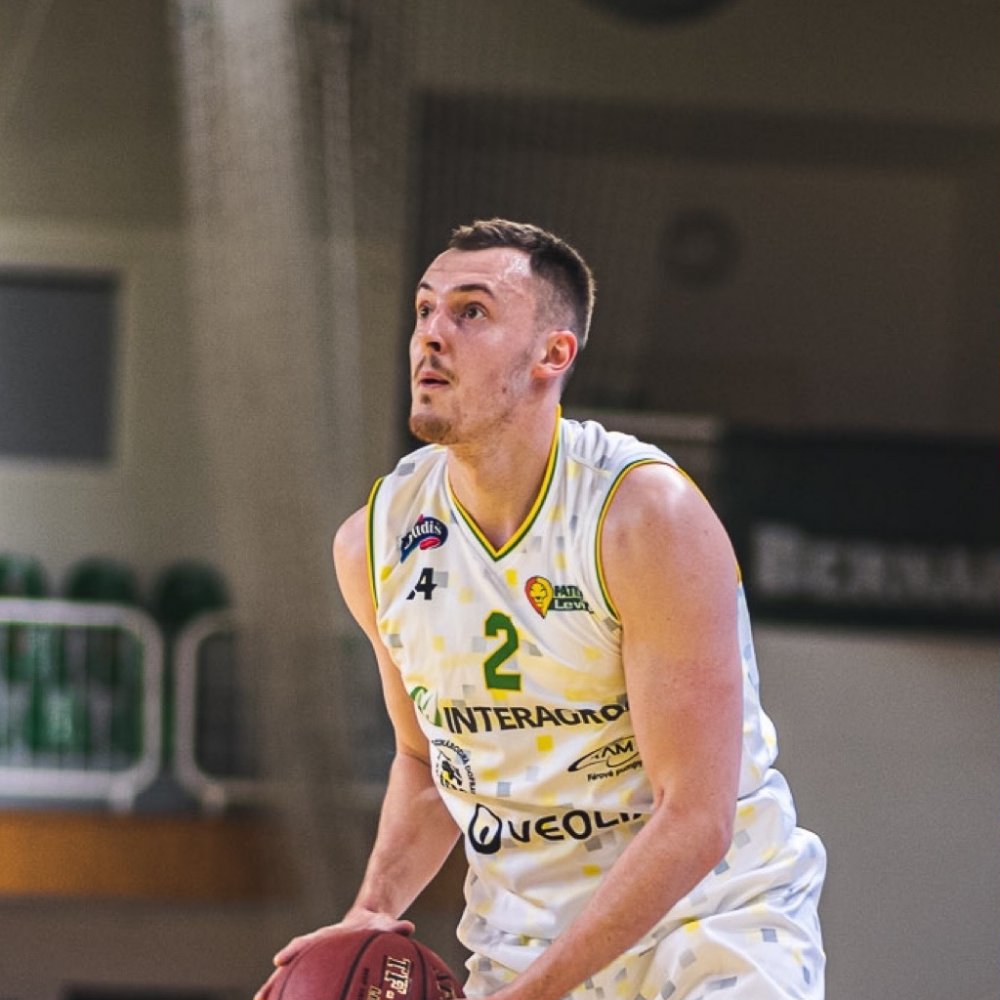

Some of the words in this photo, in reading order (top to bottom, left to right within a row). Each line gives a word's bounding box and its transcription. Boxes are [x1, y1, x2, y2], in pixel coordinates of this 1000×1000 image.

[483, 611, 523, 693] 2
[443, 704, 630, 735] INTERAGRO
[507, 809, 642, 843] VEOL
